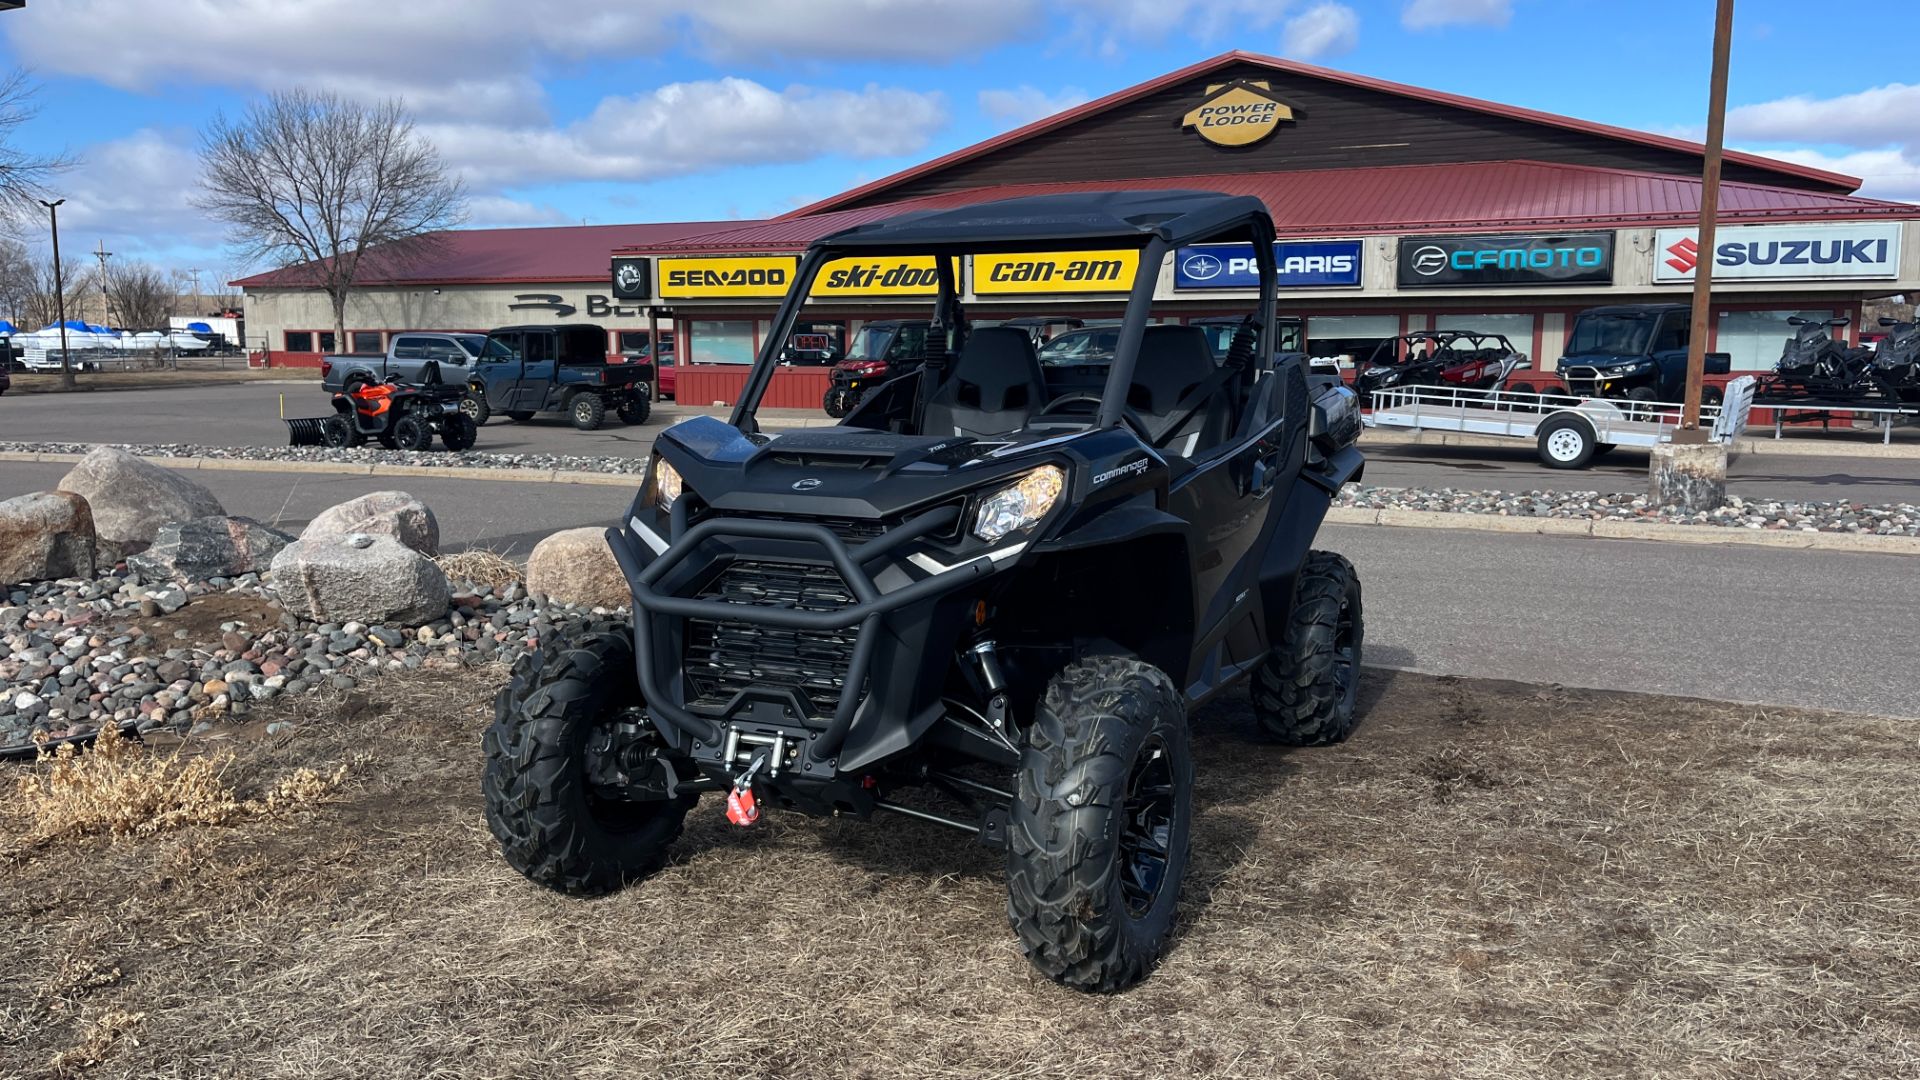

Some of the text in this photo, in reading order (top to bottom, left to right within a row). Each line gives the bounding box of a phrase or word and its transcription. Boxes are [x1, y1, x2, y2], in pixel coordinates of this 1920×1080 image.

[1199, 102, 1277, 118] POWER
[1203, 113, 1273, 127] LODGE
[1451, 247, 1602, 270] CFMOTO
[1716, 238, 1888, 267] SUZUKI
[826, 264, 938, 288] ski-doo
[990, 260, 1122, 282] can-am
[796, 335, 826, 349] OPEN
[1093, 457, 1149, 484] COMMANDER
[1136, 465, 1149, 476] XT
